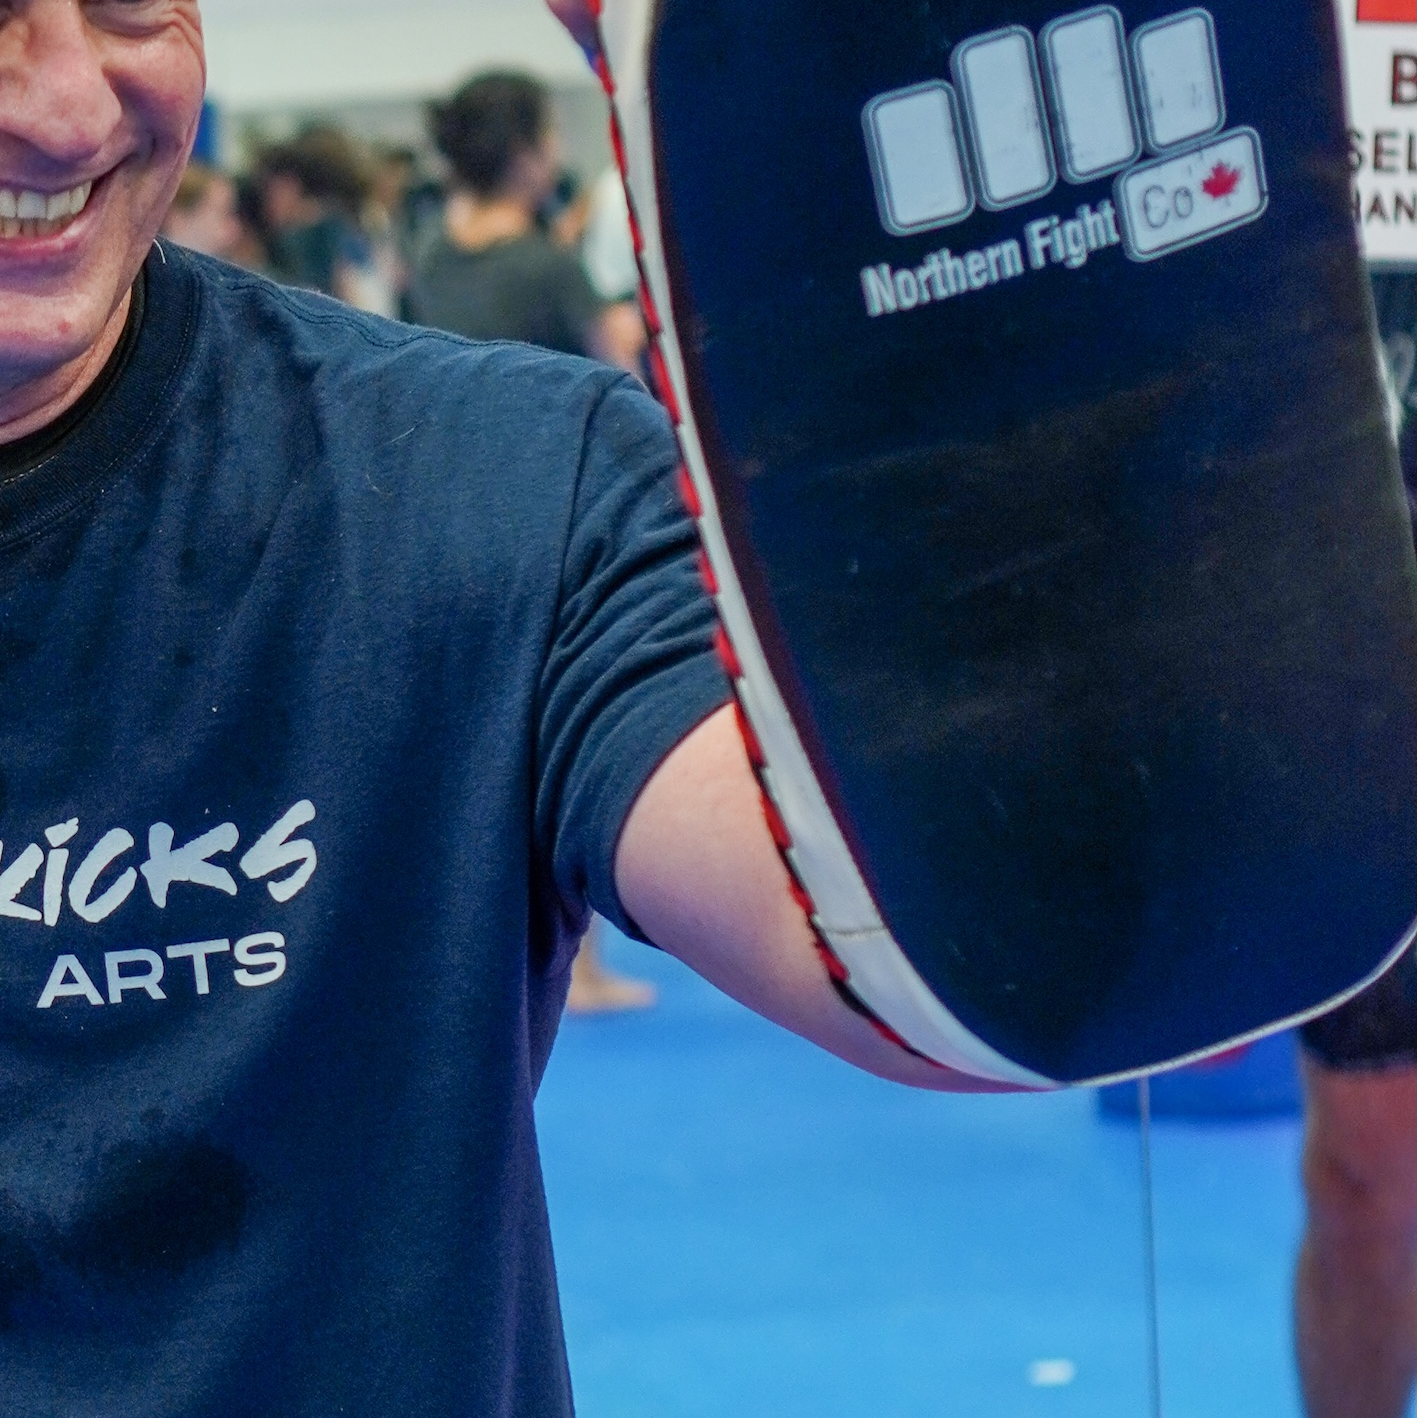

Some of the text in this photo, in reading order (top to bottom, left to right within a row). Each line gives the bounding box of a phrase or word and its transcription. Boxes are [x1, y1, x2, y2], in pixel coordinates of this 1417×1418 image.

[860, 185, 1194, 318] Northern Fight Co
[36, 931, 286, 1009] ARTS
